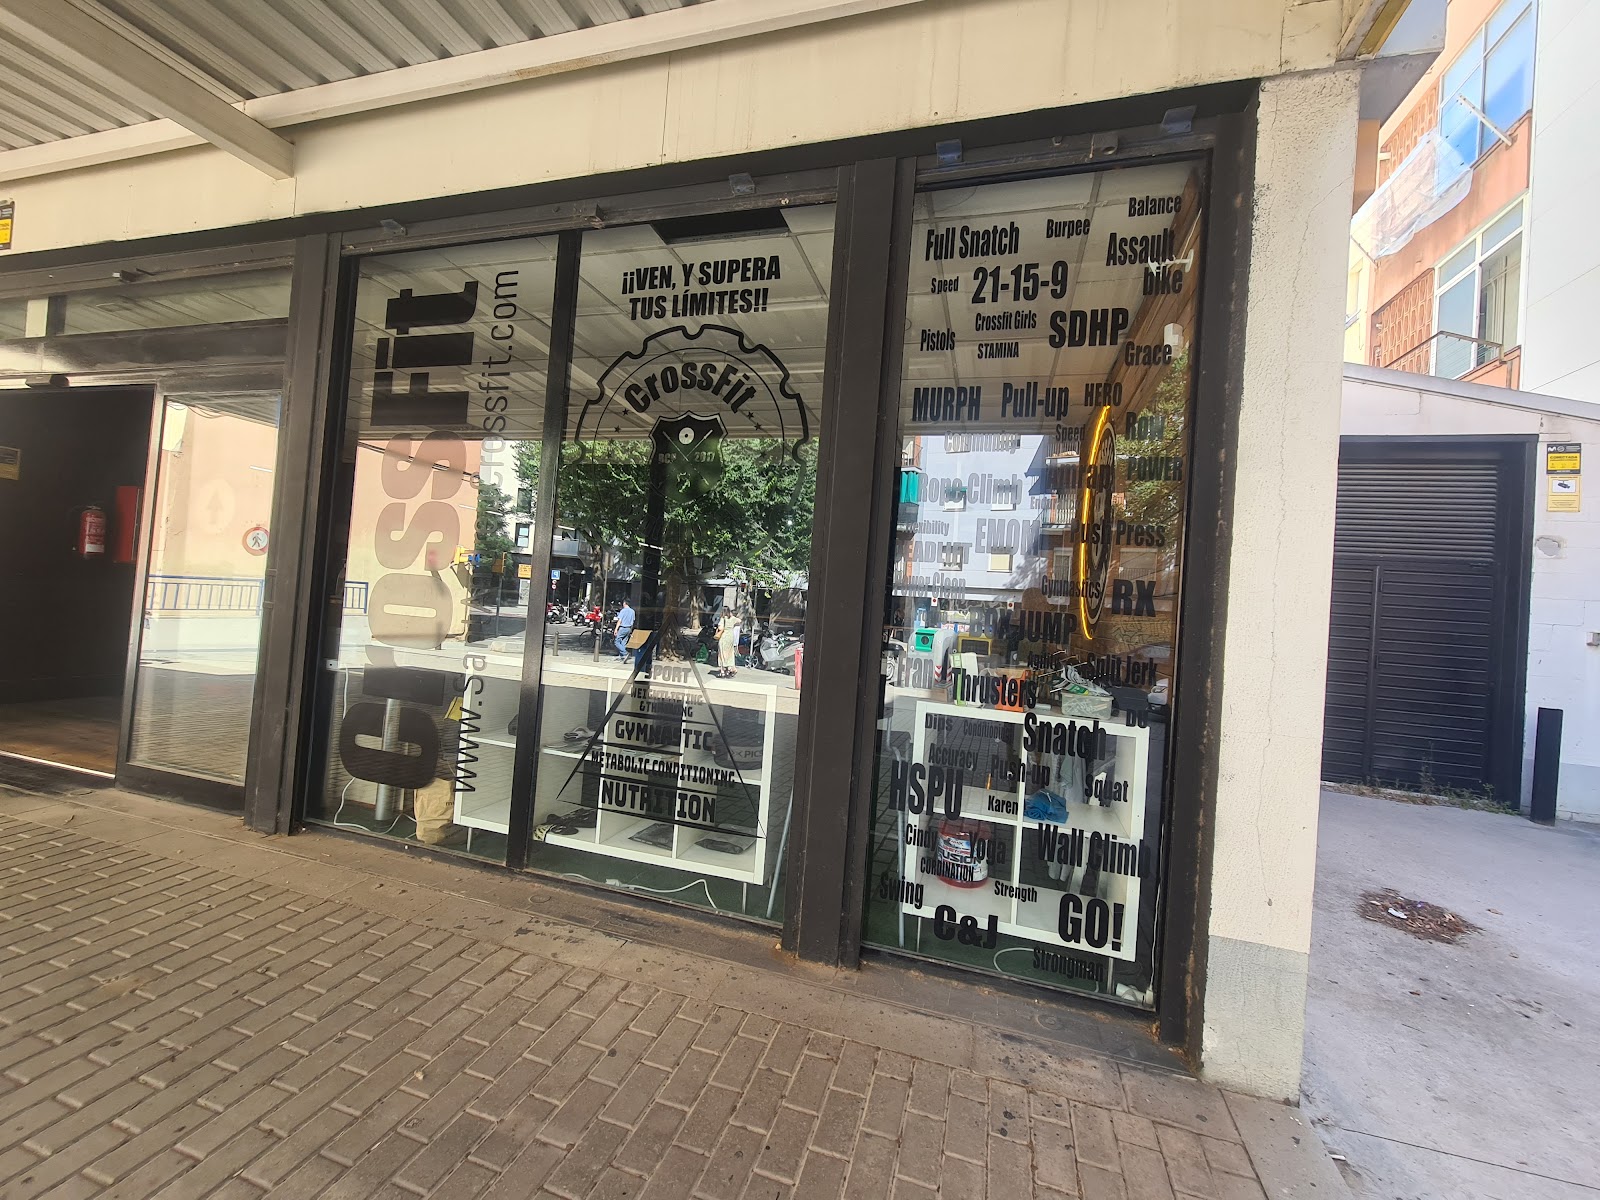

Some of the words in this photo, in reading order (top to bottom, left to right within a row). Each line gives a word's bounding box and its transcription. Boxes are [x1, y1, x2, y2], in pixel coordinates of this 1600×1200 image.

[1128, 194, 1181, 217] Balance
[925, 227, 956, 261] Full
[959, 222, 1020, 259] Snatch
[1046, 218, 1090, 239] Burpee
[1106, 228, 1175, 266] Assault
[621, 266, 676, 294] ¡¡VEN,
[682, 263, 694, 287] Y
[699, 256, 781, 286] SUPERA
[931, 276, 959, 294] Speed
[971, 260, 1069, 304] 21-15-9
[1142, 264, 1183, 295] bike
[629, 296, 667, 320] TUS
[672, 288, 769, 317] LÍMITES!!
[975, 311, 1012, 331] Crossfit
[1014, 310, 1037, 329] Girls
[1049, 308, 1129, 348] SDHP
[920, 329, 956, 351] Pistols
[977, 342, 1019, 359] STAMINA
[1124, 341, 1172, 367] Grace
[912, 386, 982, 421] MURPH
[1001, 382, 1069, 421] Pull-up
[1084, 381, 1122, 406] HERO
[944, 431, 1018, 454] Community
[1055, 424, 1086, 442] Speed
[1127, 456, 1183, 481] POWER
[918, 473, 963, 506] Rope
[967, 473, 1023, 505] Climb
[975, 518, 1041, 556] EMOM
[1070, 518, 1112, 545] Push
[1116, 519, 1166, 547] Press
[932, 572, 966, 599] Clean
[1112, 579, 1157, 617] RX
[1018, 610, 1077, 644] JUMP
[1125, 656, 1157, 686] Jerk
[952, 668, 1037, 709] Thrusters
[1023, 712, 1107, 760] Snatch
[591, 751, 649, 776] METABOLIC
[928, 743, 979, 771] Accuracy
[991, 754, 1050, 787] Push-up
[601, 780, 716, 823] NUTRITION
[889, 759, 964, 820] HSPU
[1085, 773, 1129, 803] Squat
[988, 795, 1018, 815] Karen
[906, 823, 938, 853] Cindy
[969, 832, 1006, 864] Yoga
[1038, 823, 1084, 867] Wall
[879, 873, 924, 910] Swing
[994, 881, 1038, 902] Strength
[933, 904, 998, 949] C&J
[1058, 893, 1125, 952] GO!
[1033, 947, 1104, 982] Strongman
